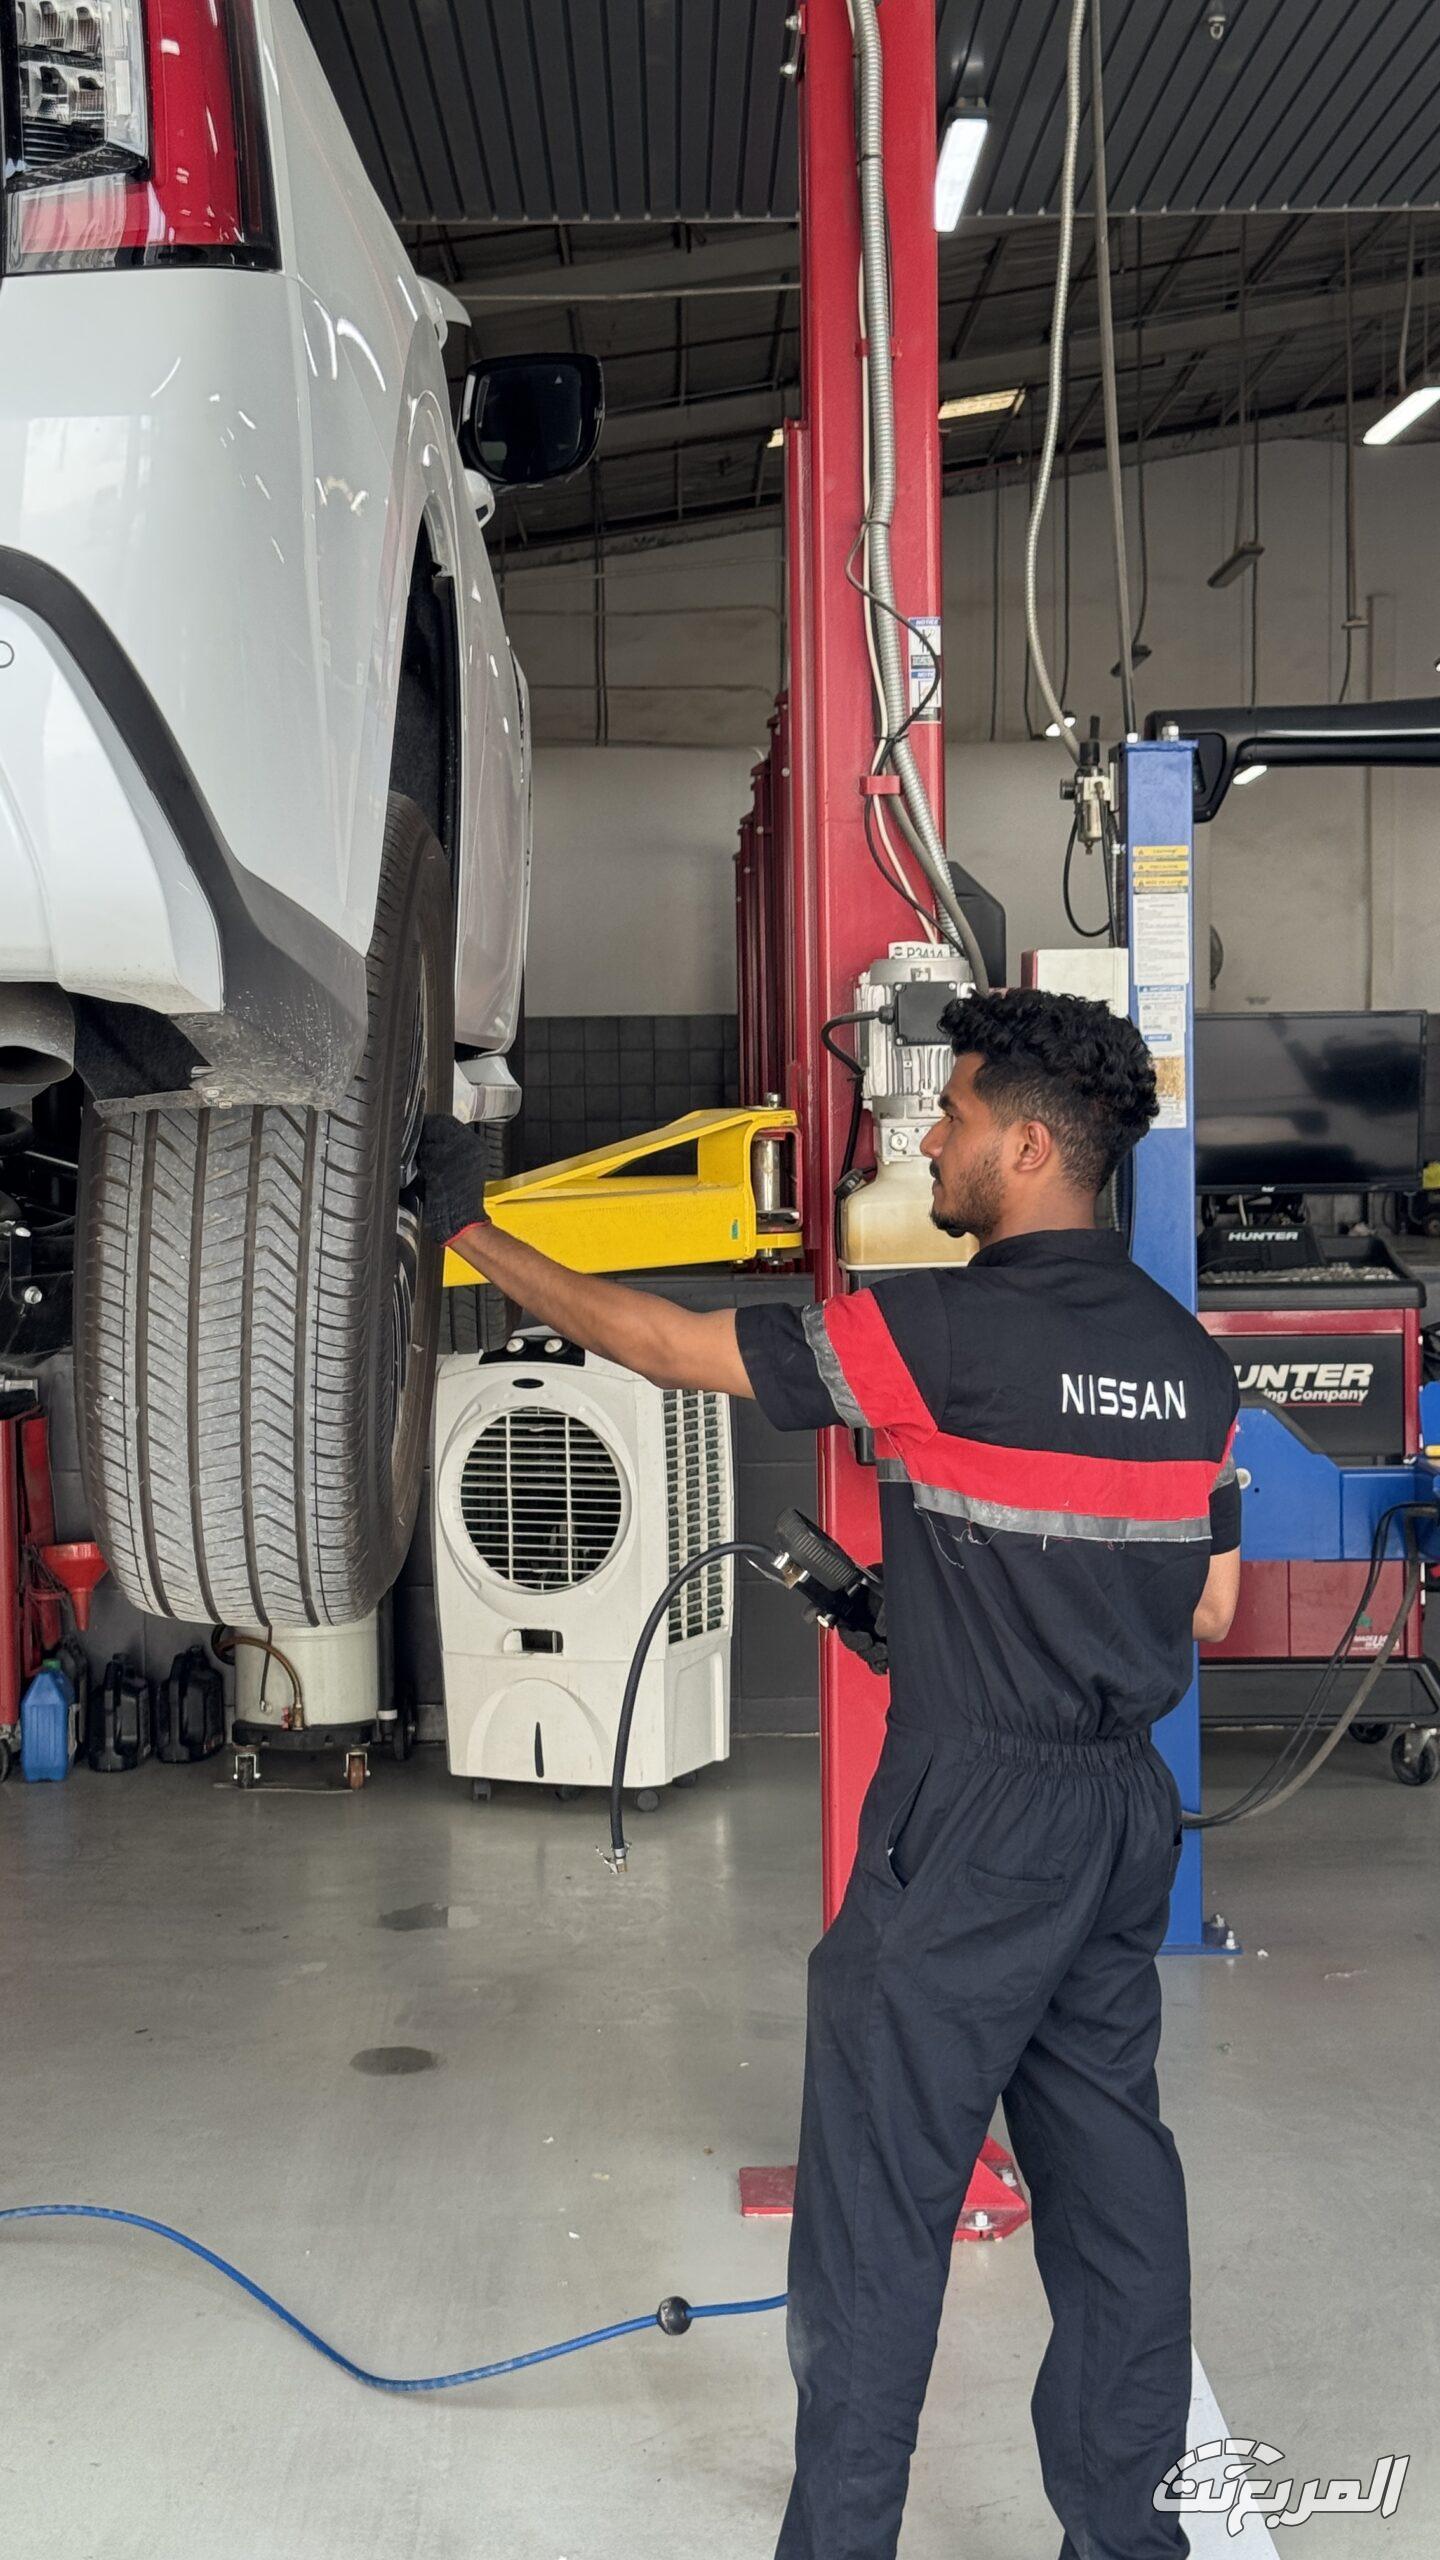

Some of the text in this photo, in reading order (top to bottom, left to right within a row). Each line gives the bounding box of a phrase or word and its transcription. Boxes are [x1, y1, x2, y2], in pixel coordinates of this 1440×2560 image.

[1228, 1231, 1299, 1241] HUNTER
[1233, 1363, 1374, 1390] UNTER
[1061, 1373, 1187, 1420] NISSAN
[1290, 1387, 1369, 1403] Company
